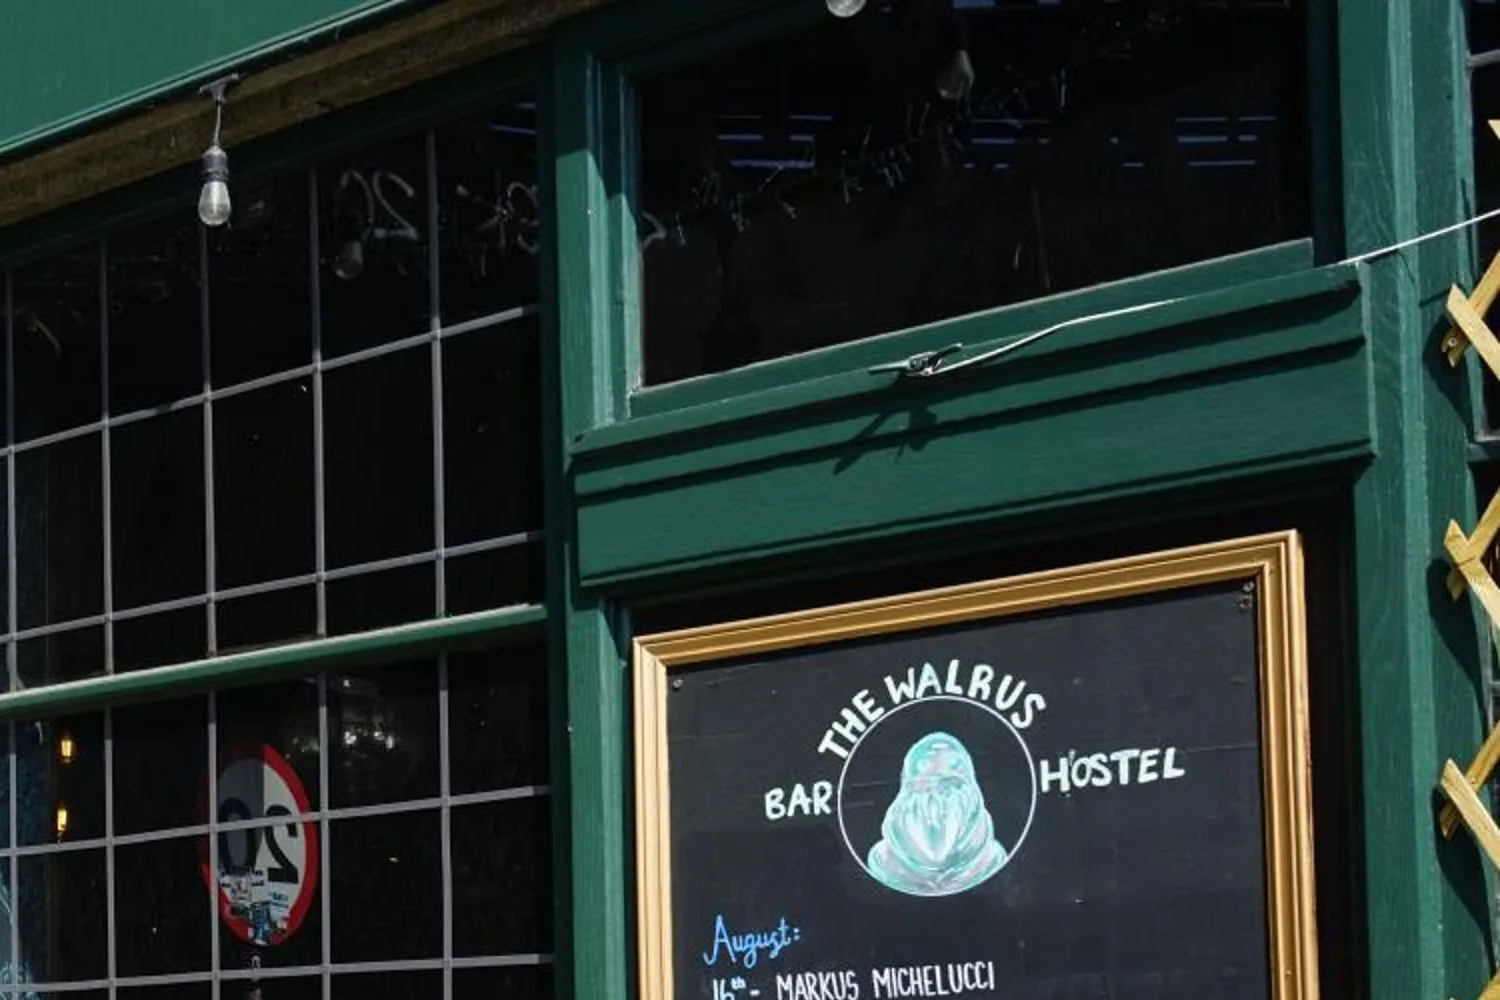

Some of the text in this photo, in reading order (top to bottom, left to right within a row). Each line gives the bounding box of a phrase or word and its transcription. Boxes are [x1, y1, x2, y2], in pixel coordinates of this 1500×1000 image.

[817, 659, 1047, 763] THE WALRUS
[1040, 747, 1186, 795] HOSTEL
[765, 781, 833, 820] BAR
[871, 961, 995, 999] MICHELUCCI
